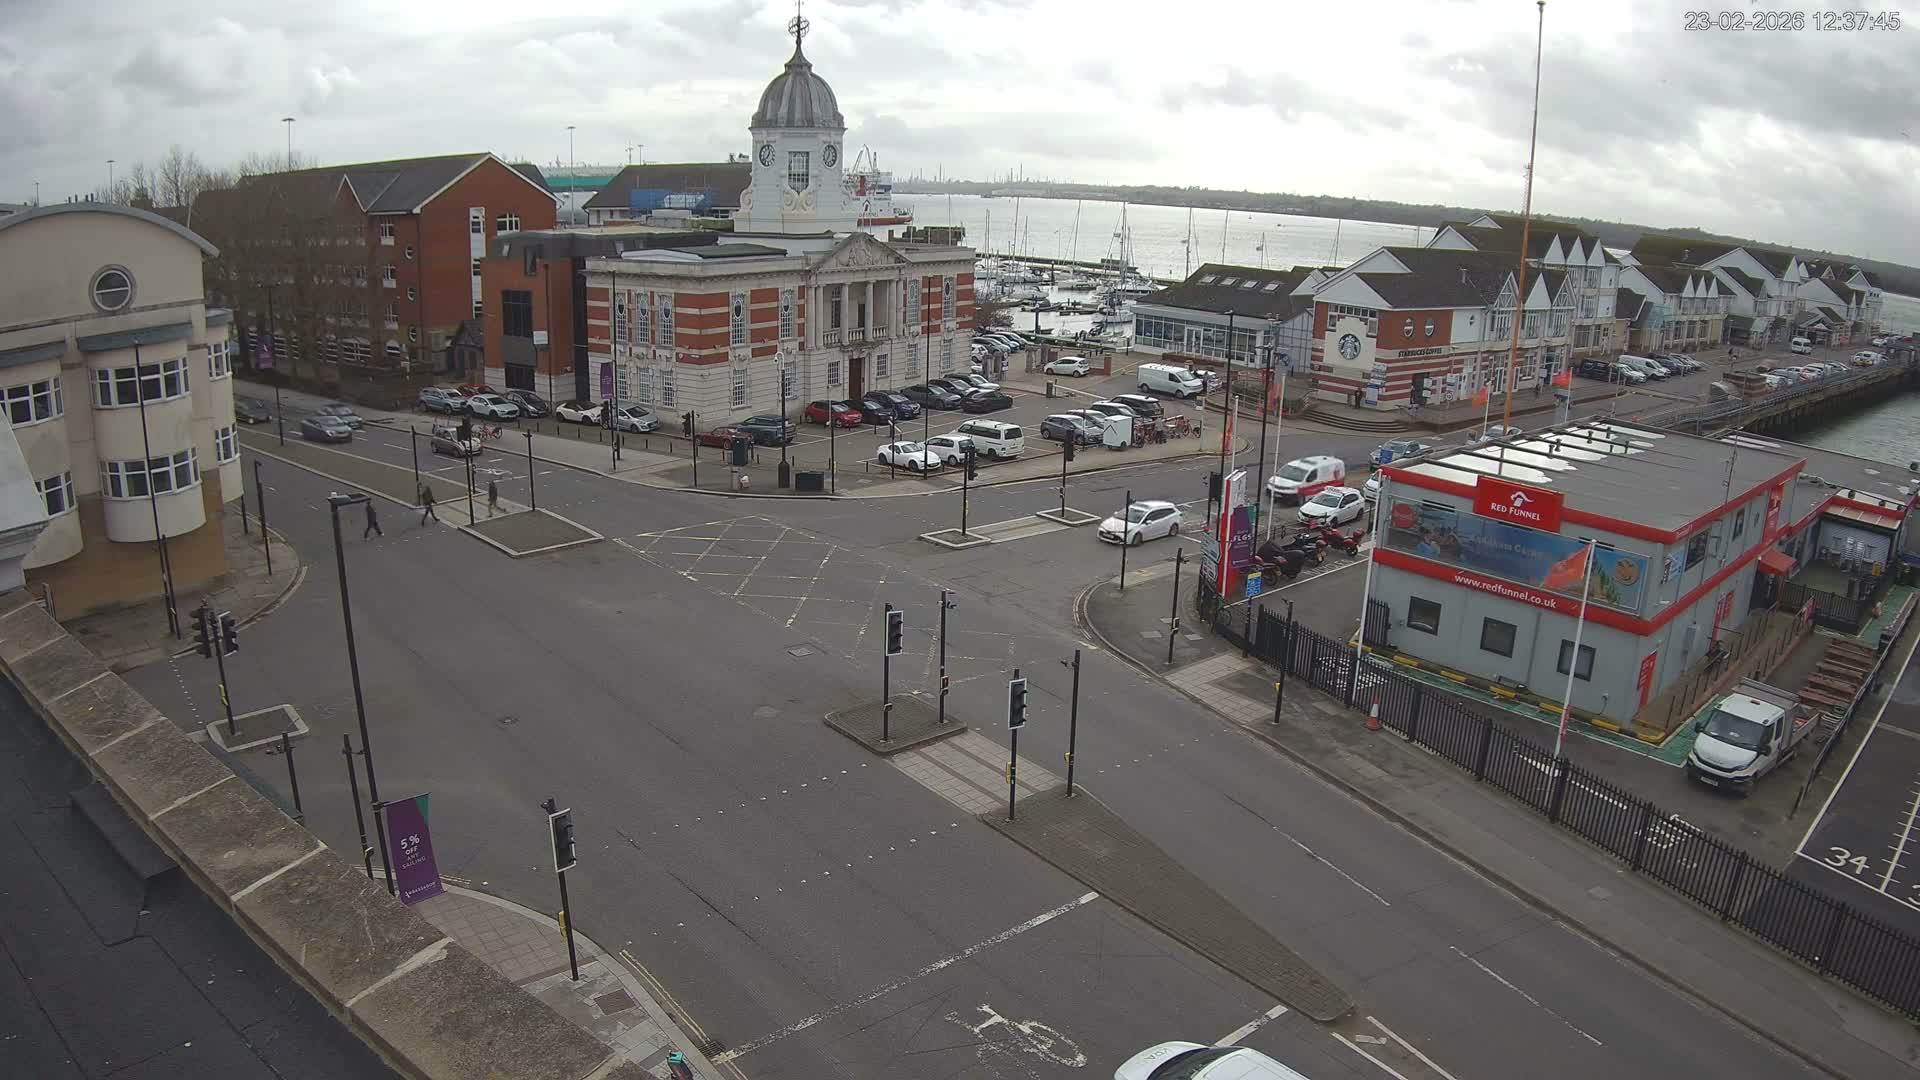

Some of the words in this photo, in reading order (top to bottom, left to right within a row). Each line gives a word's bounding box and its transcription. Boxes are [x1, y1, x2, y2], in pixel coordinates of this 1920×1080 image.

[1398, 348, 1425, 358] STARBUCKS
[1426, 347, 1442, 355] COFFEE
[1491, 502, 1507, 513] RED
[1509, 506, 1541, 521] FUNNEL
[1454, 575, 1557, 609] www.redfunnel.co.uk
[405, 845, 418, 855] OFF
[407, 853, 418, 861] ANY
[402, 855, 426, 870] SAILING
[1824, 846, 1871, 875] 34
